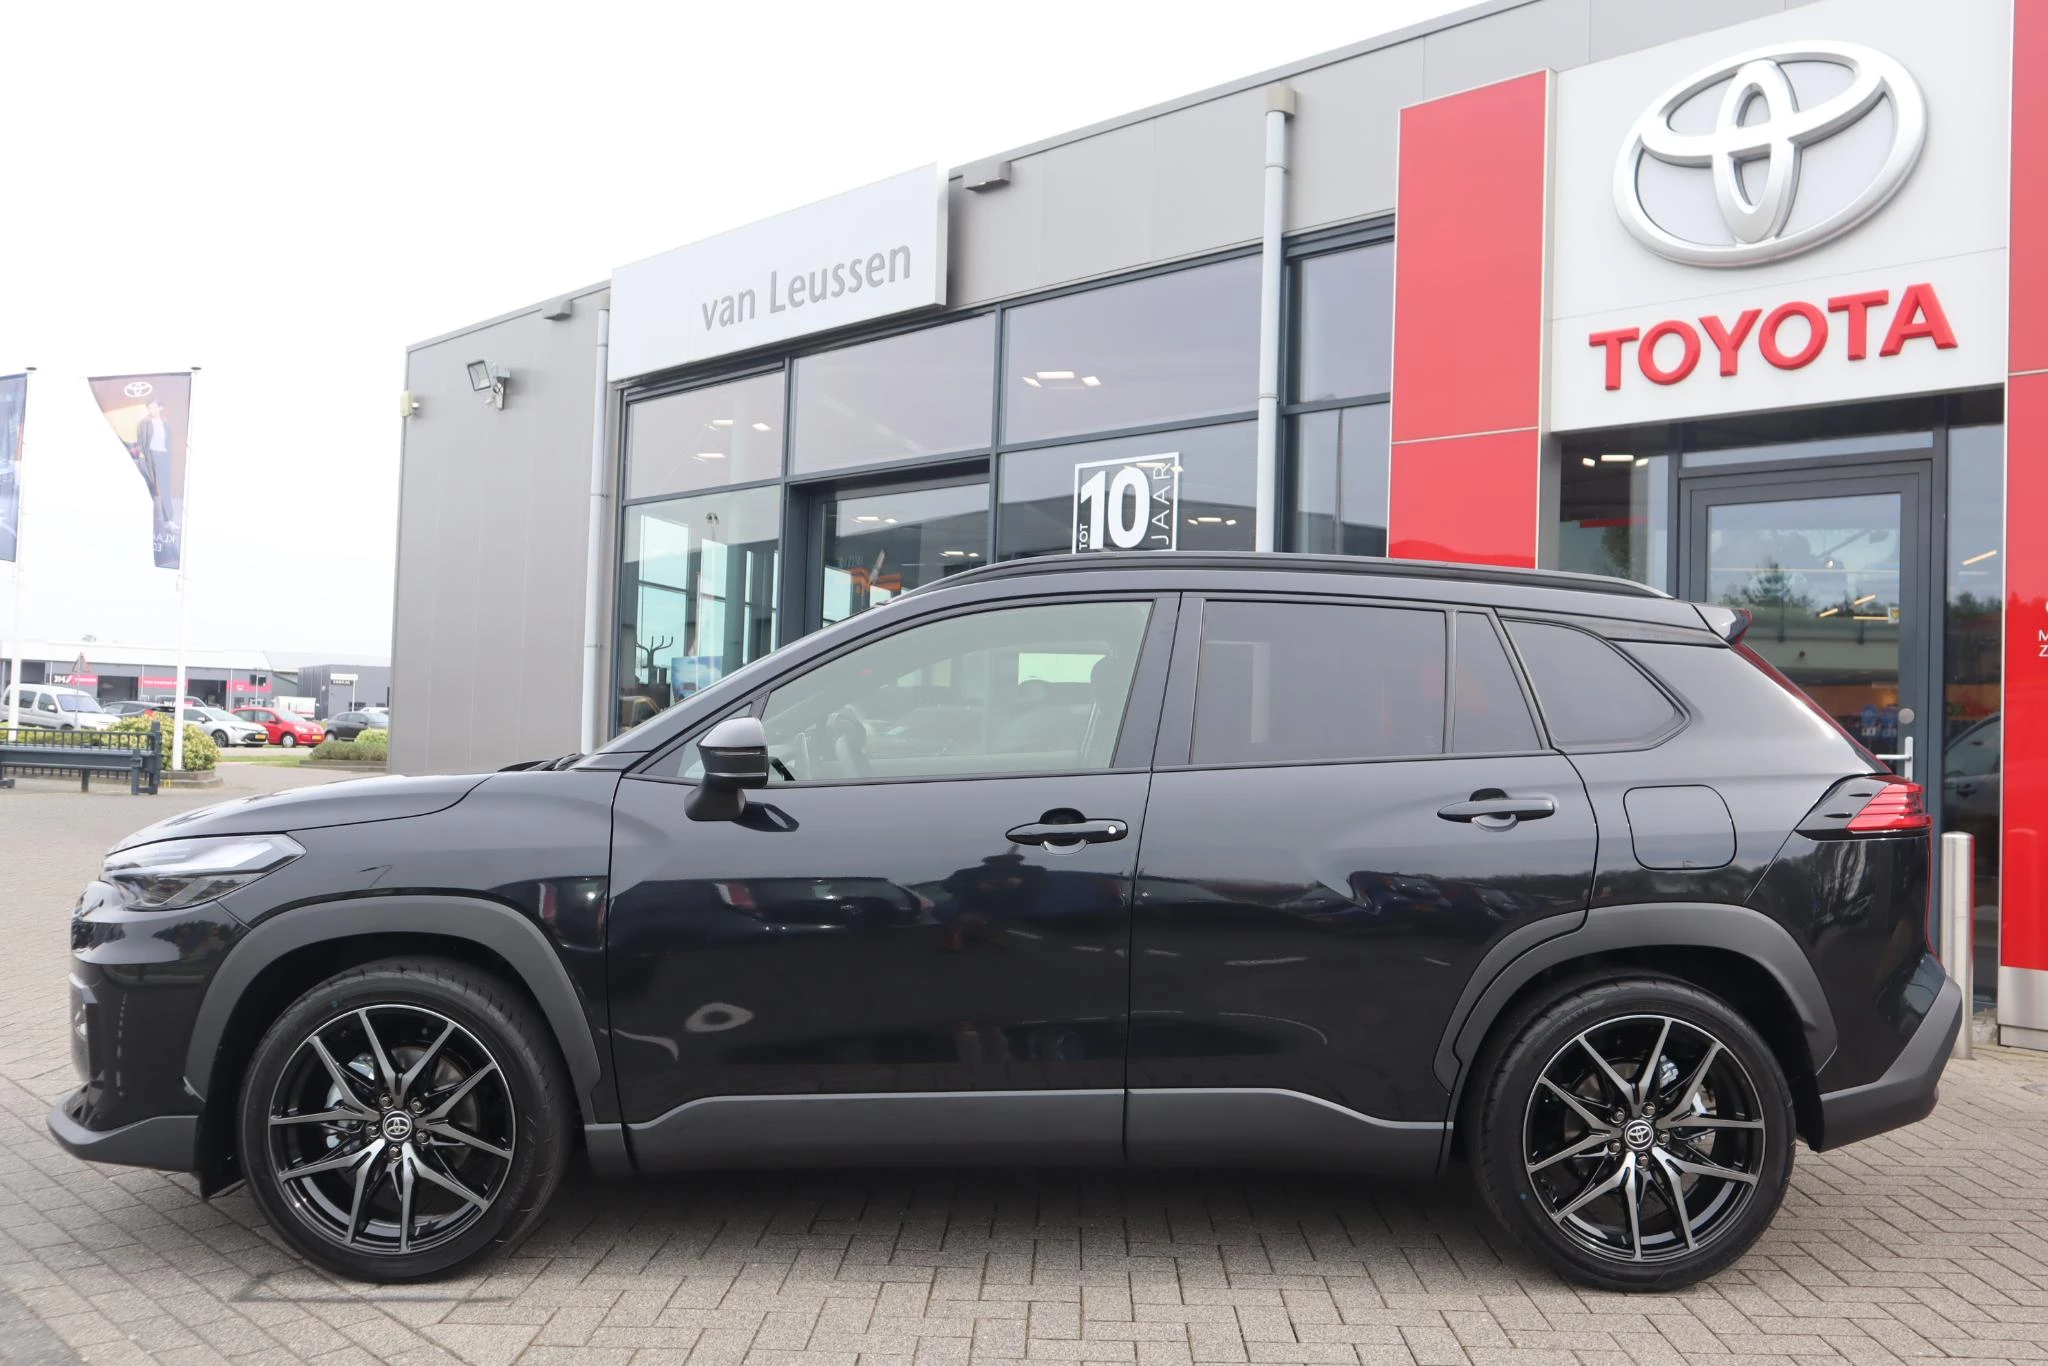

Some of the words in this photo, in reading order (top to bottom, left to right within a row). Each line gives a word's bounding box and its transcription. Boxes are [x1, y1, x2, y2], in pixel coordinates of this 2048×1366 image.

[702, 288, 756, 331] van
[769, 245, 911, 314] Leussen
[1589, 283, 1959, 391] TOYOTA
[1078, 523, 1089, 551] TOT
[1080, 465, 1151, 550] 10
[1151, 462, 1172, 546] JAAR
